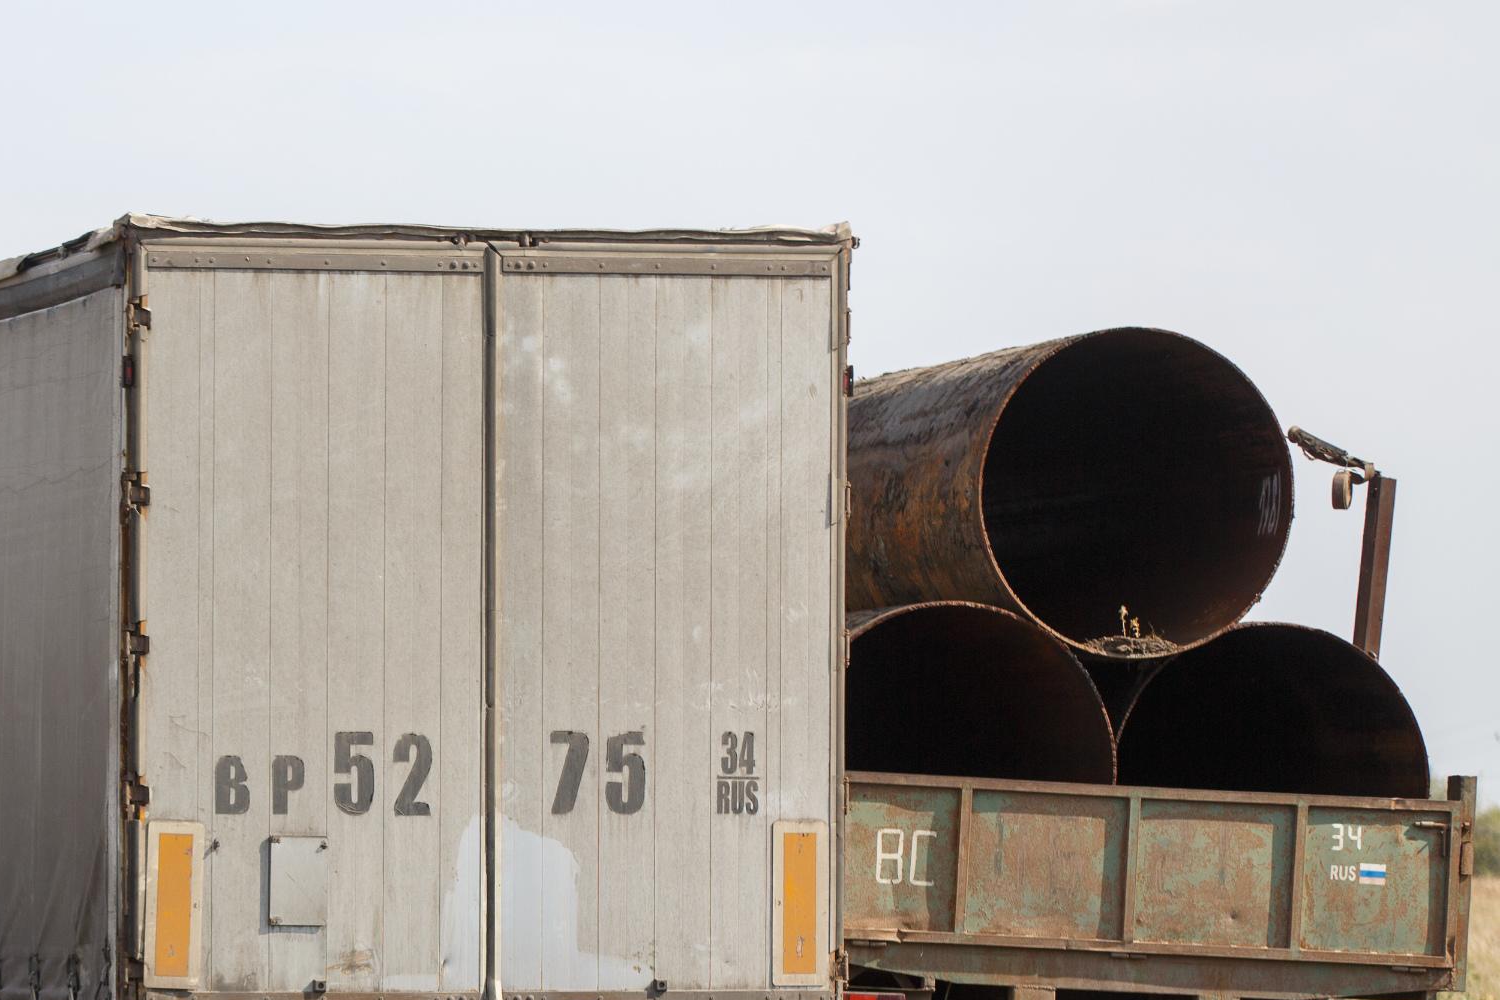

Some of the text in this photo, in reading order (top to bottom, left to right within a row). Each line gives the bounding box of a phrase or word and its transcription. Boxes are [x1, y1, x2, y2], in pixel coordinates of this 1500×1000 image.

[720, 731, 756, 776] 34
[333, 731, 433, 817] 52
[549, 730, 647, 816] 75
[716, 779, 760, 815] RUS
[1331, 823, 1362, 851] 34
[1330, 864, 1357, 882] RUS
